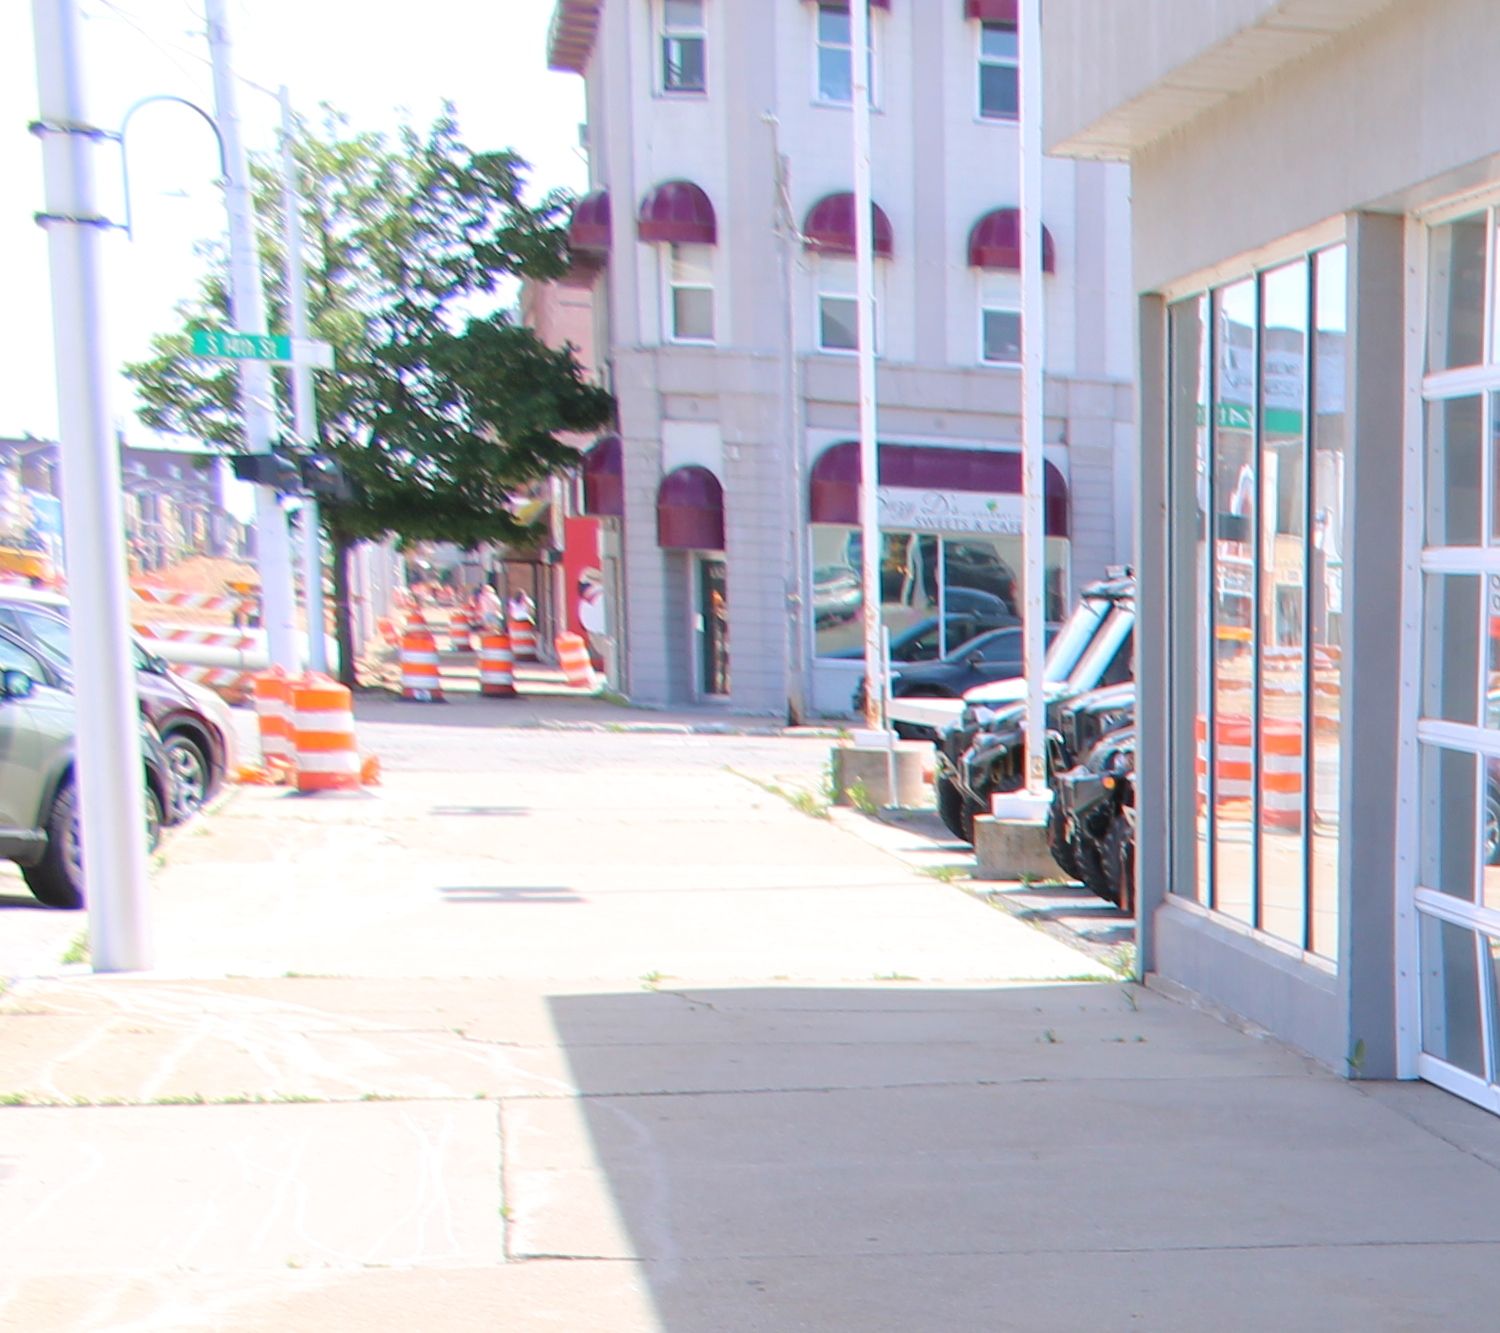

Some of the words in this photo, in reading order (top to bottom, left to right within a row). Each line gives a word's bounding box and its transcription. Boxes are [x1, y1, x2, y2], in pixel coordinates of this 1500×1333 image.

[205, 333, 219, 355] S
[222, 335, 257, 357] 14th
[259, 337, 279, 359] St
